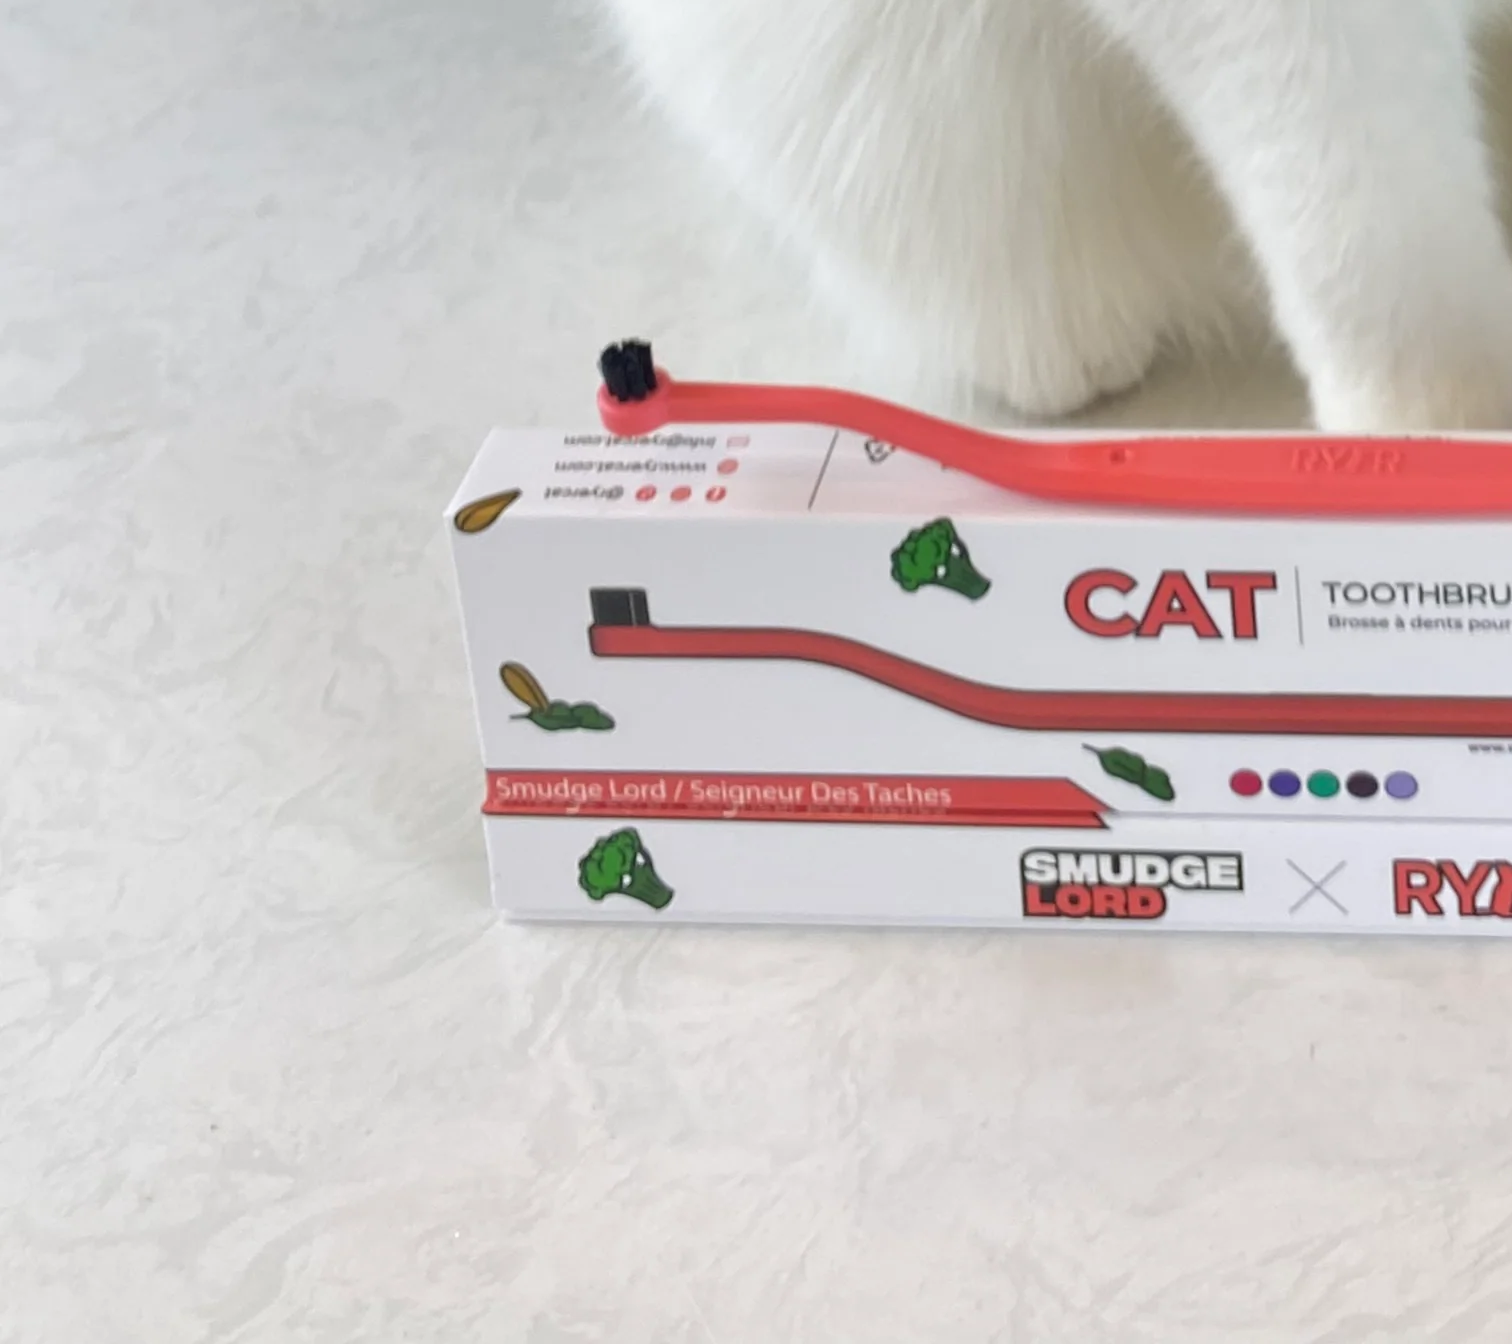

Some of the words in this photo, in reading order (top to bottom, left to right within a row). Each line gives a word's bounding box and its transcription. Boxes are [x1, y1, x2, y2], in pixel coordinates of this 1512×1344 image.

[543, 484, 624, 500] @ryercat
[1064, 567, 1277, 640] CAT
[1327, 614, 1390, 630] Brosse
[1395, 615, 1405, 630] à
[1410, 615, 1463, 631] dents
[1468, 617, 1511, 634] pour
[496, 776, 602, 814] Smudge
[609, 779, 667, 800] Lord
[690, 780, 805, 818] Seigneur
[811, 782, 859, 803] Des
[864, 782, 952, 806] Taches
[1024, 853, 1239, 888] SMUDGE
[1023, 884, 1166, 918] LORD
